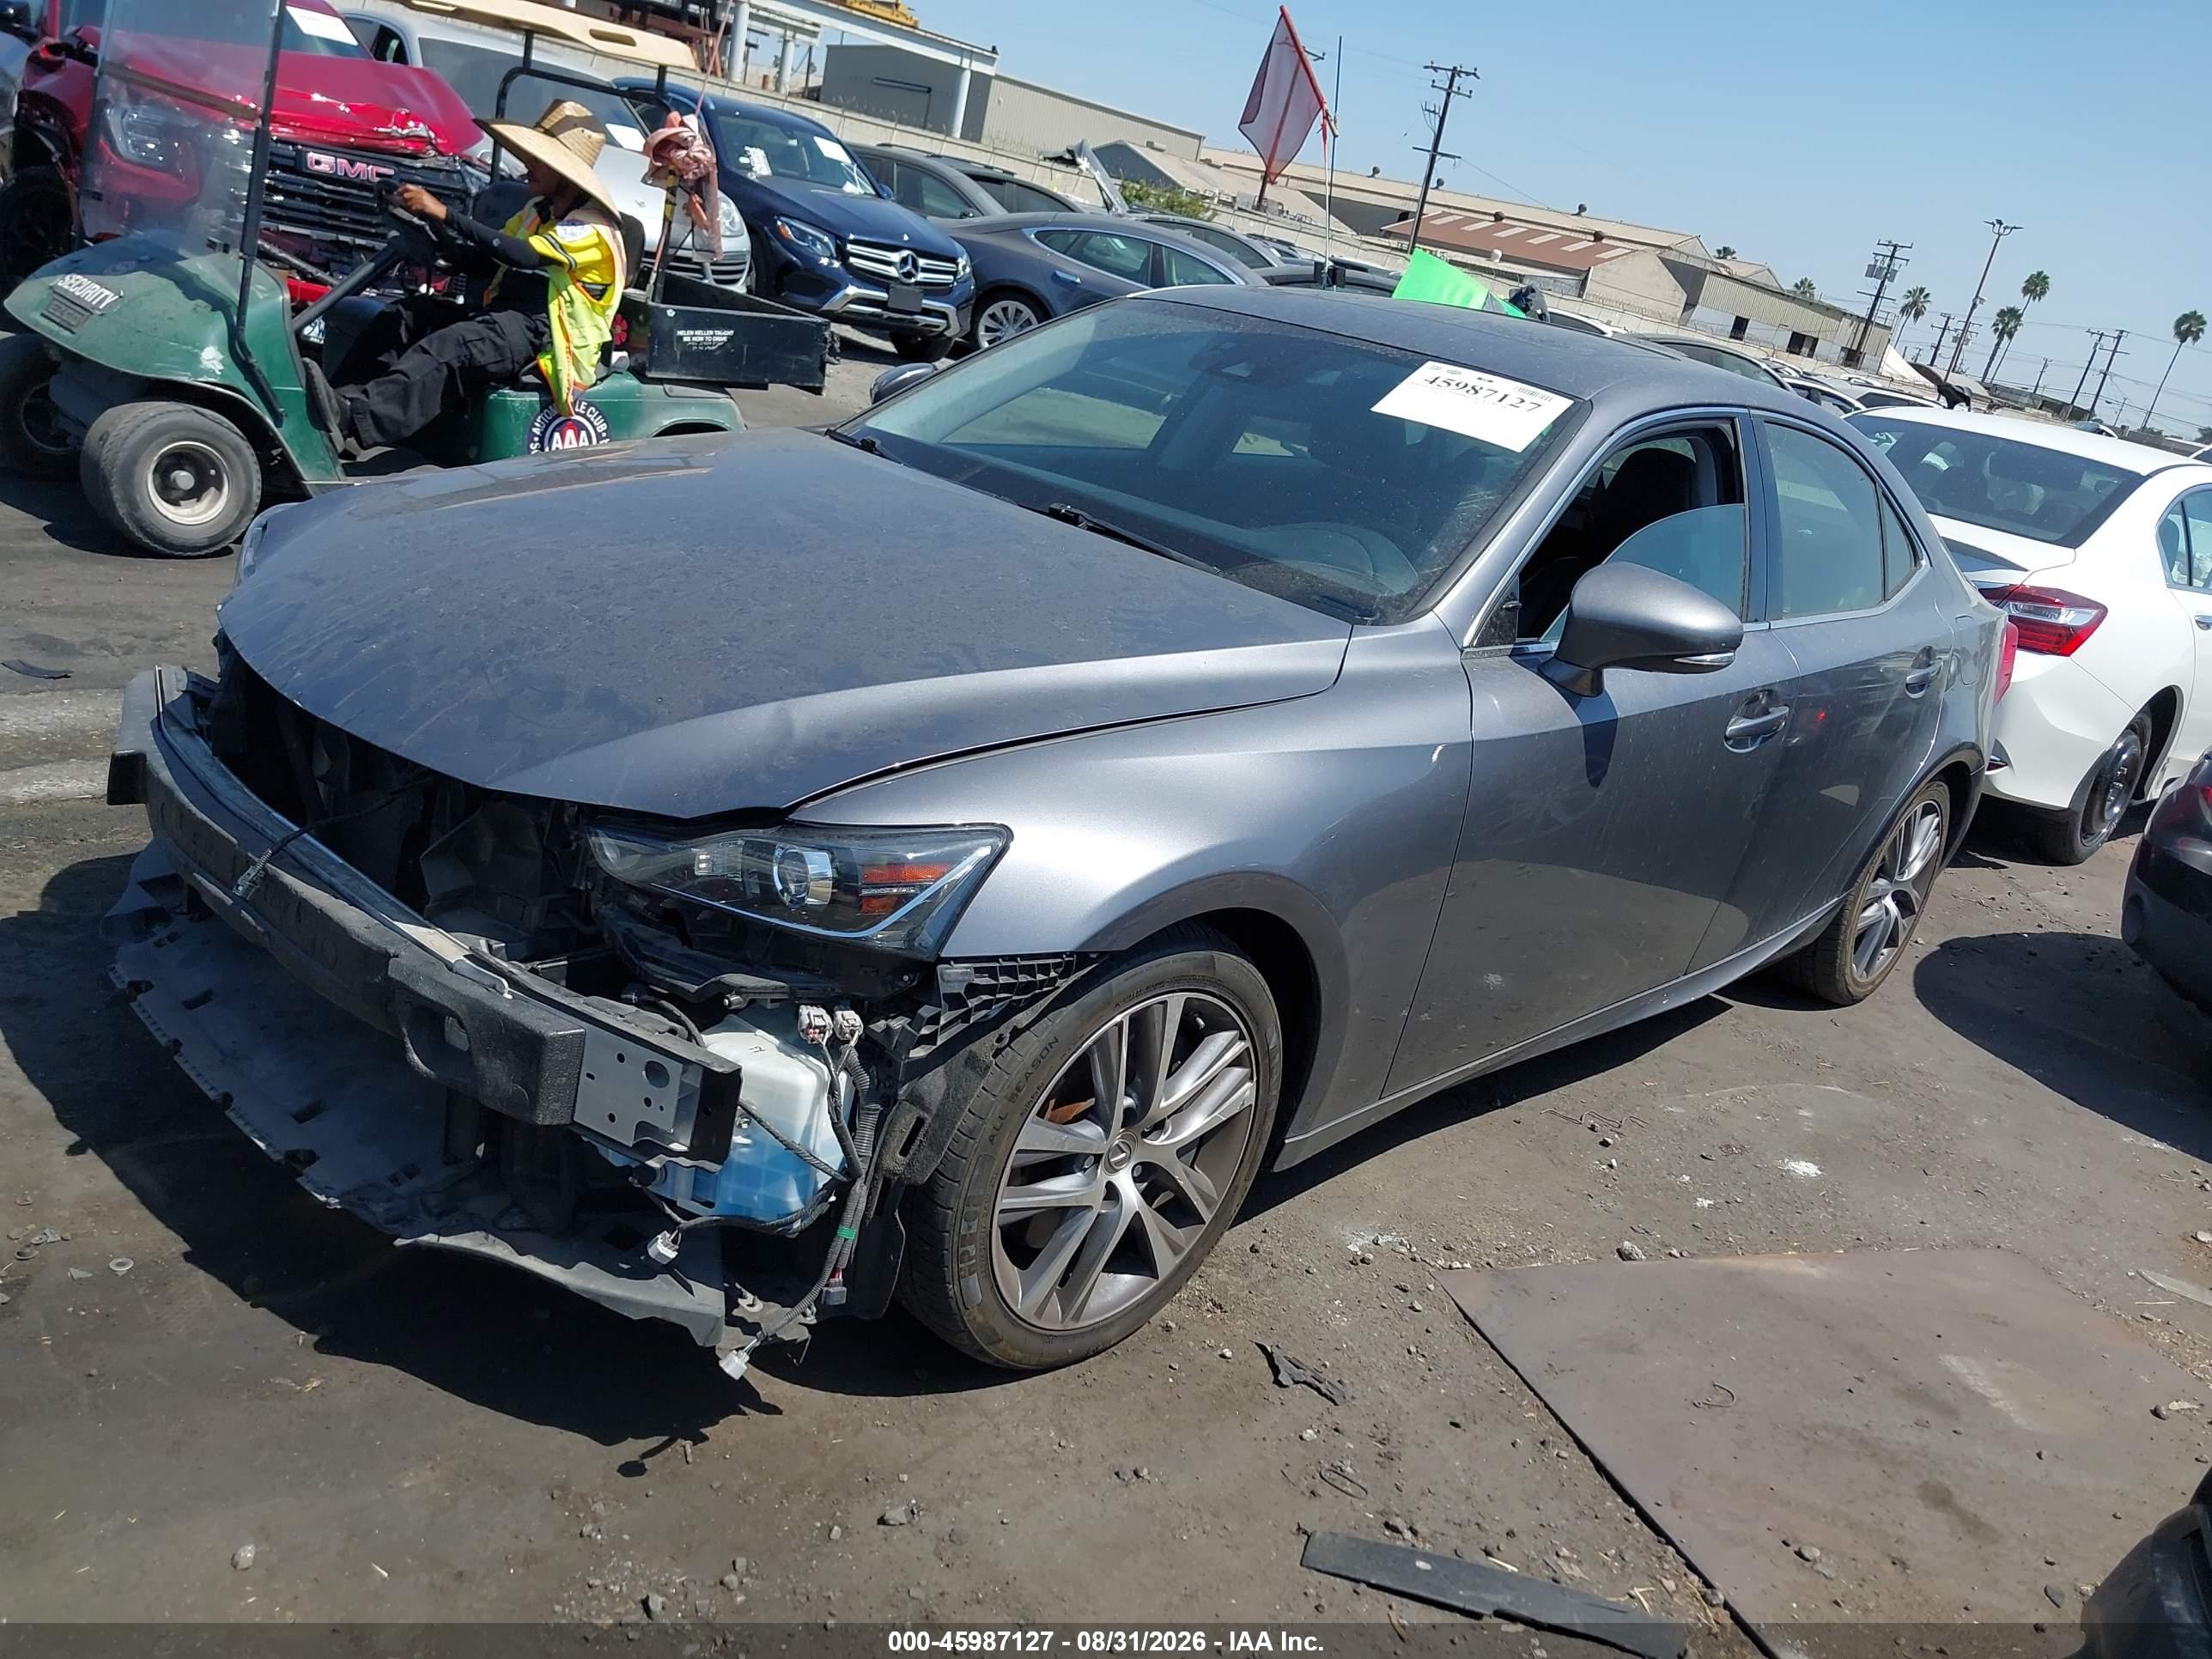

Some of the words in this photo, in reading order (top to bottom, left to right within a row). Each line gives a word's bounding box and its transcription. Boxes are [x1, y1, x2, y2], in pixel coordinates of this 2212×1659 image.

[307, 151, 395, 182] GMC
[57, 273, 119, 309] SECURITY
[1423, 375, 1543, 412] 45987127
[586, 406, 607, 433] CLUB
[550, 428, 590, 451] AAA
[988, 1112, 1009, 1145] ALL
[1008, 1036, 1059, 1103] SEASON
